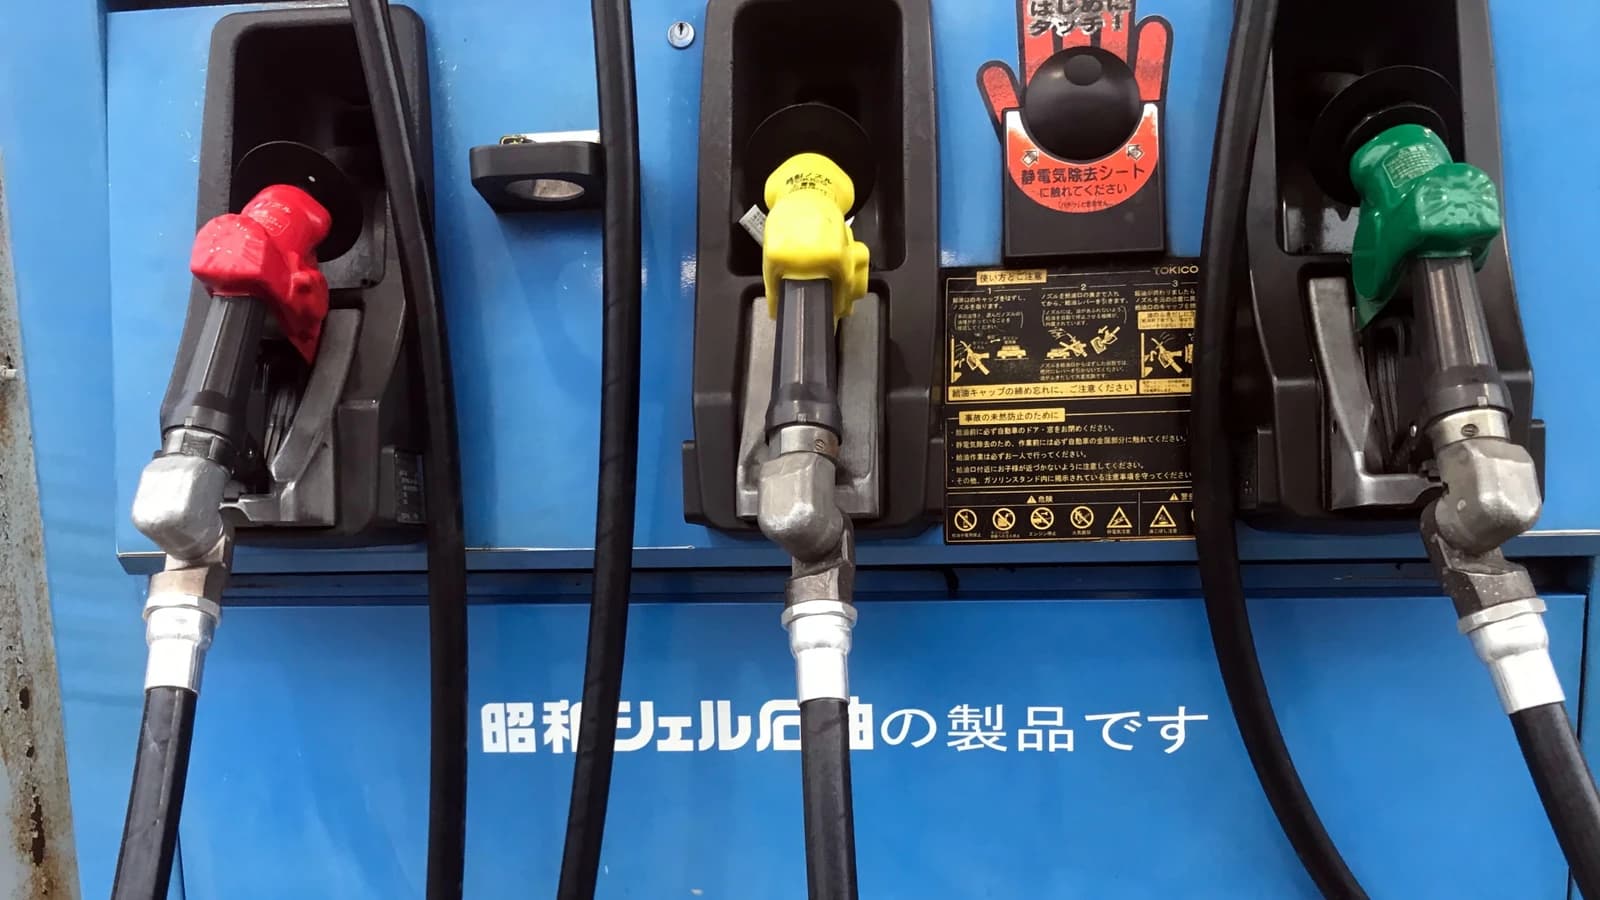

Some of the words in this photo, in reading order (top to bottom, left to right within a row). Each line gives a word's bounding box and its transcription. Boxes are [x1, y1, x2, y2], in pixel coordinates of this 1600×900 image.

[1021, 164, 1145, 185] 静電気除去シート
[1040, 184, 1128, 198] に触れてください
[1152, 265, 1199, 275] TOKICO
[980, 272, 1043, 283] 使い方とご注意
[1081, 283, 1087, 291] 2
[952, 383, 1134, 398] 給油キャップの締め忘れに、ご注意ください
[965, 411, 1059, 422] 事故の未然防止のために
